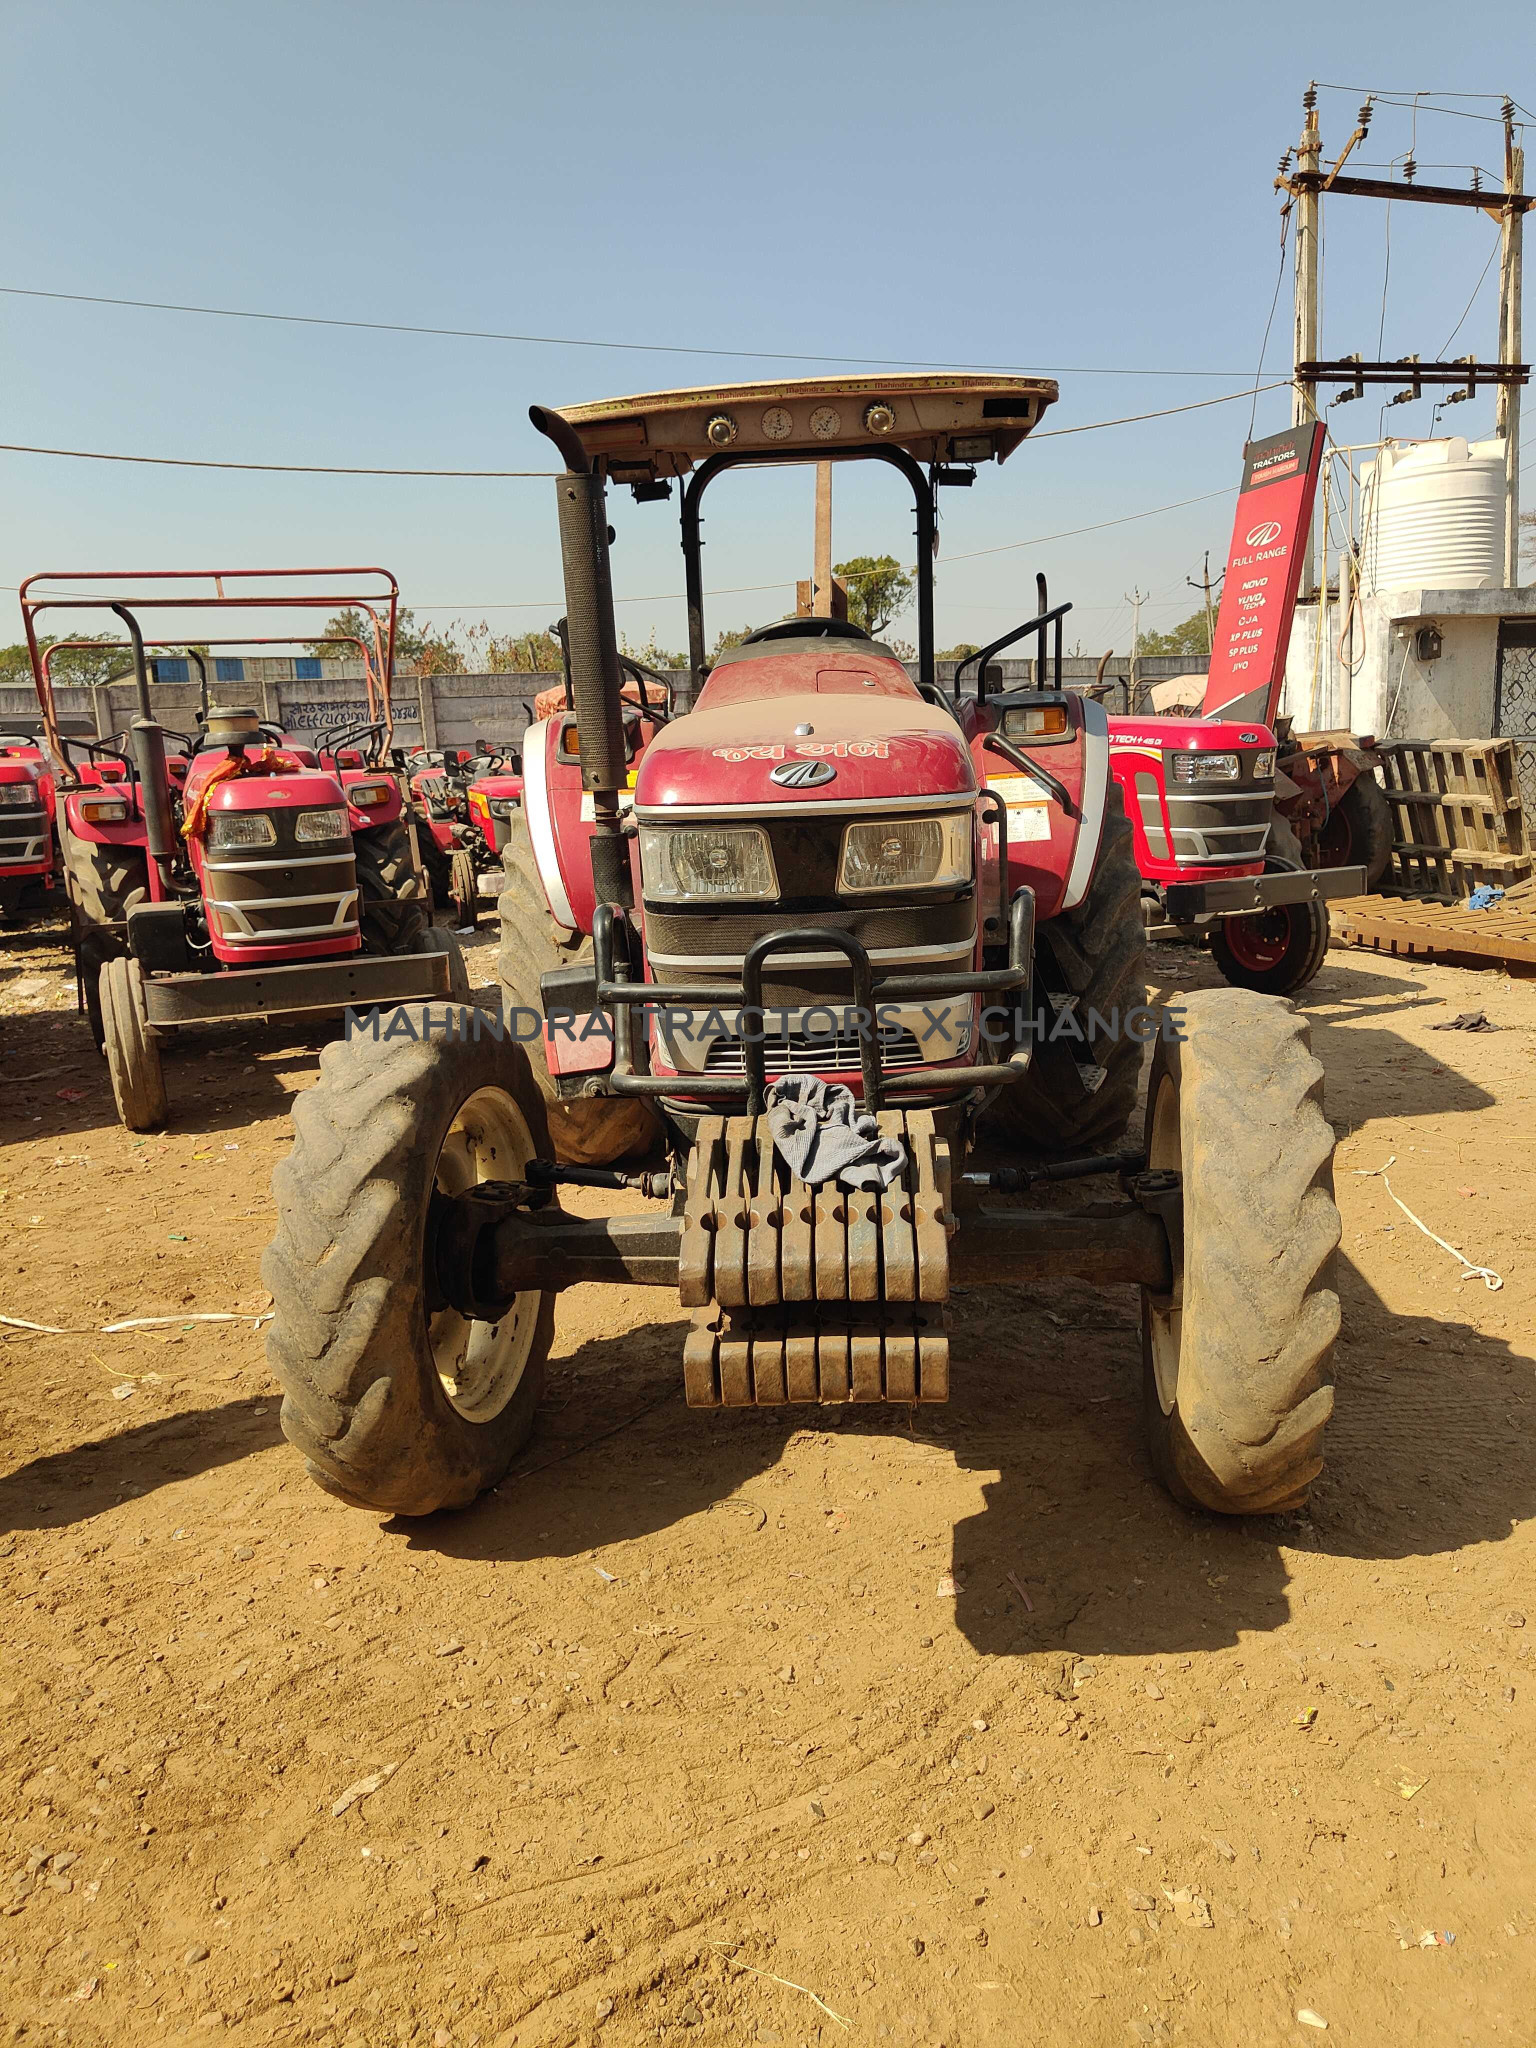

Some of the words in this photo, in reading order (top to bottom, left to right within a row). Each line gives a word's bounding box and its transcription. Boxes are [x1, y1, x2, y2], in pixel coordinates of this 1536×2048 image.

[1252, 449, 1296, 470] TRACTORS
[1232, 555, 1254, 568] FULL
[1256, 545, 1288, 562] RANGE
[1242, 577, 1268, 590] NOVO
[1238, 592, 1263, 605] YUVO
[1229, 632, 1241, 642] XP
[1241, 628, 1263, 640] PLUS
[1228, 648, 1239, 657] SP
[1239, 644, 1258, 655] PLUS
[1232, 661, 1249, 673] JIVO
